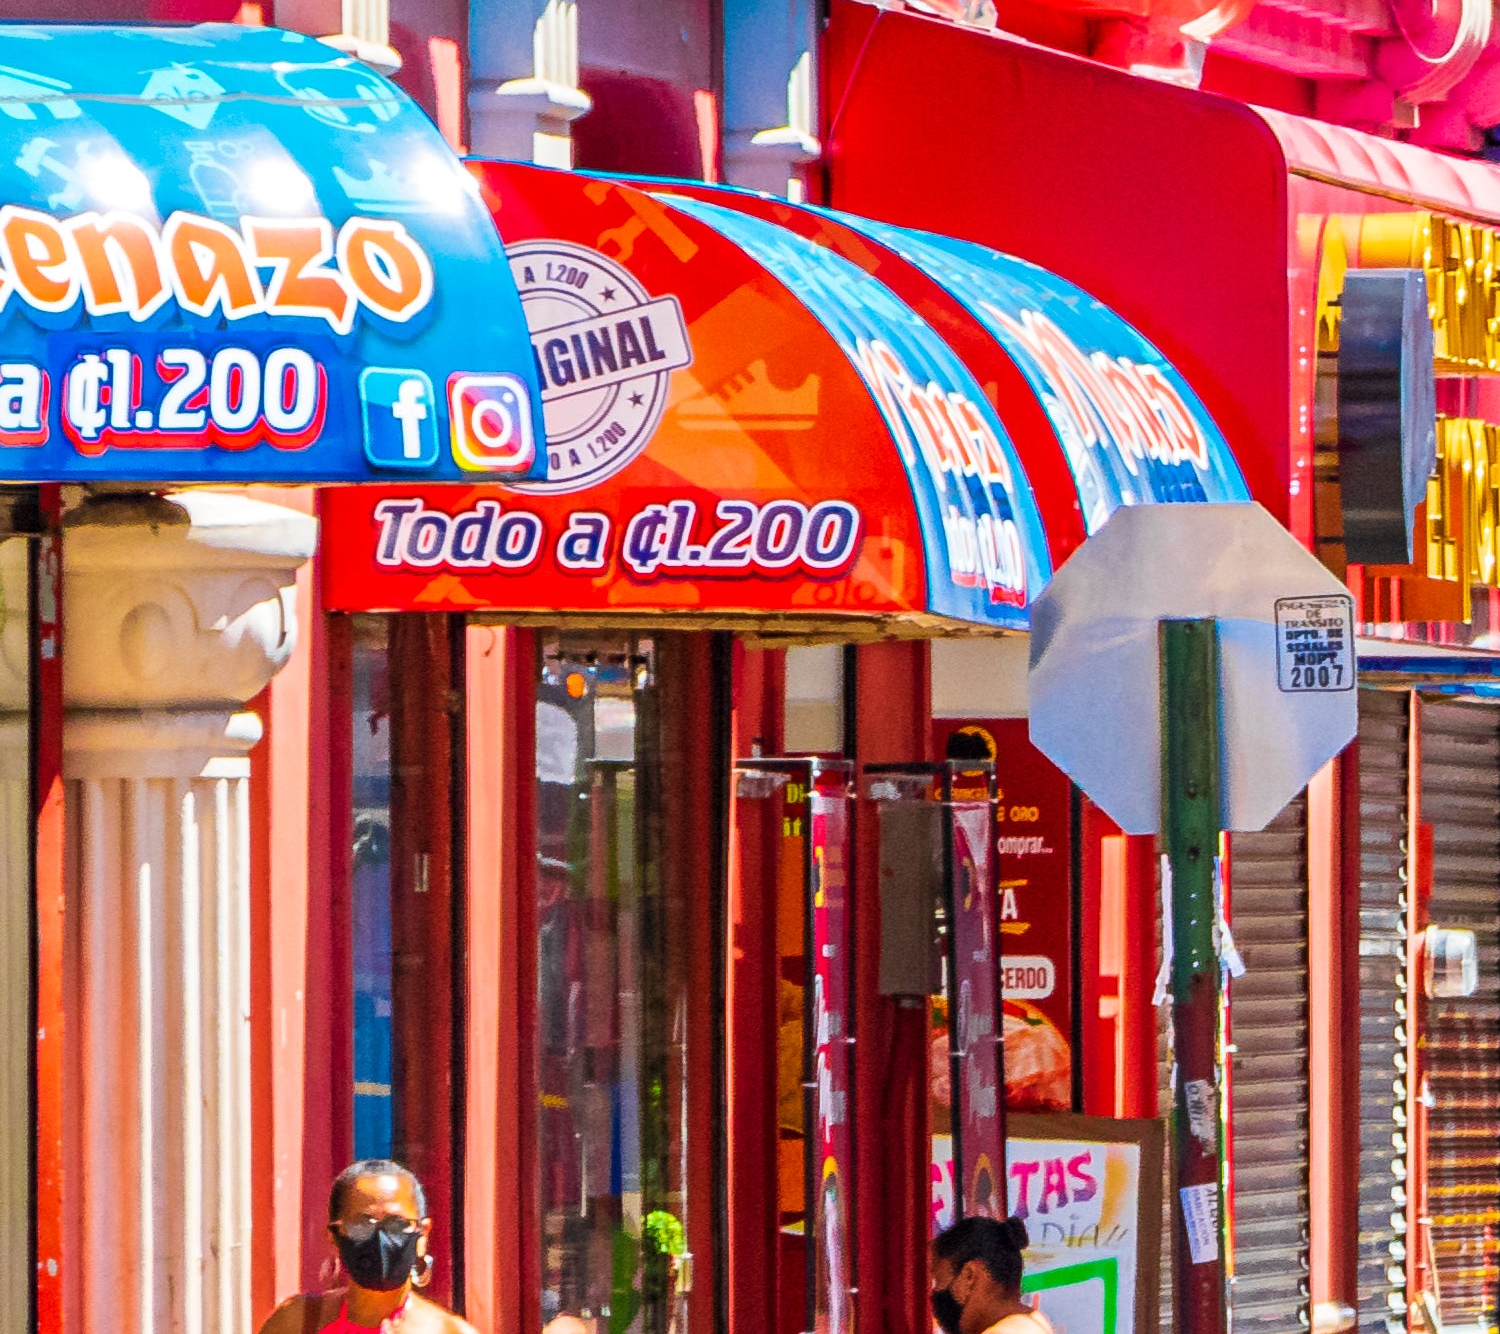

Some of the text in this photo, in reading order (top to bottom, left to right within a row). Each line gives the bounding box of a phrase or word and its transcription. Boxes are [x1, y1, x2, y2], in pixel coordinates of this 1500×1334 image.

[0, 205, 434, 335] enazo
[374, 499, 542, 568] Todo
[560, 515, 608, 566] a
[1294, 652, 1338, 666] MOPT
[1291, 664, 1344, 688] 2007
[1001, 966, 1048, 991] ERDO
